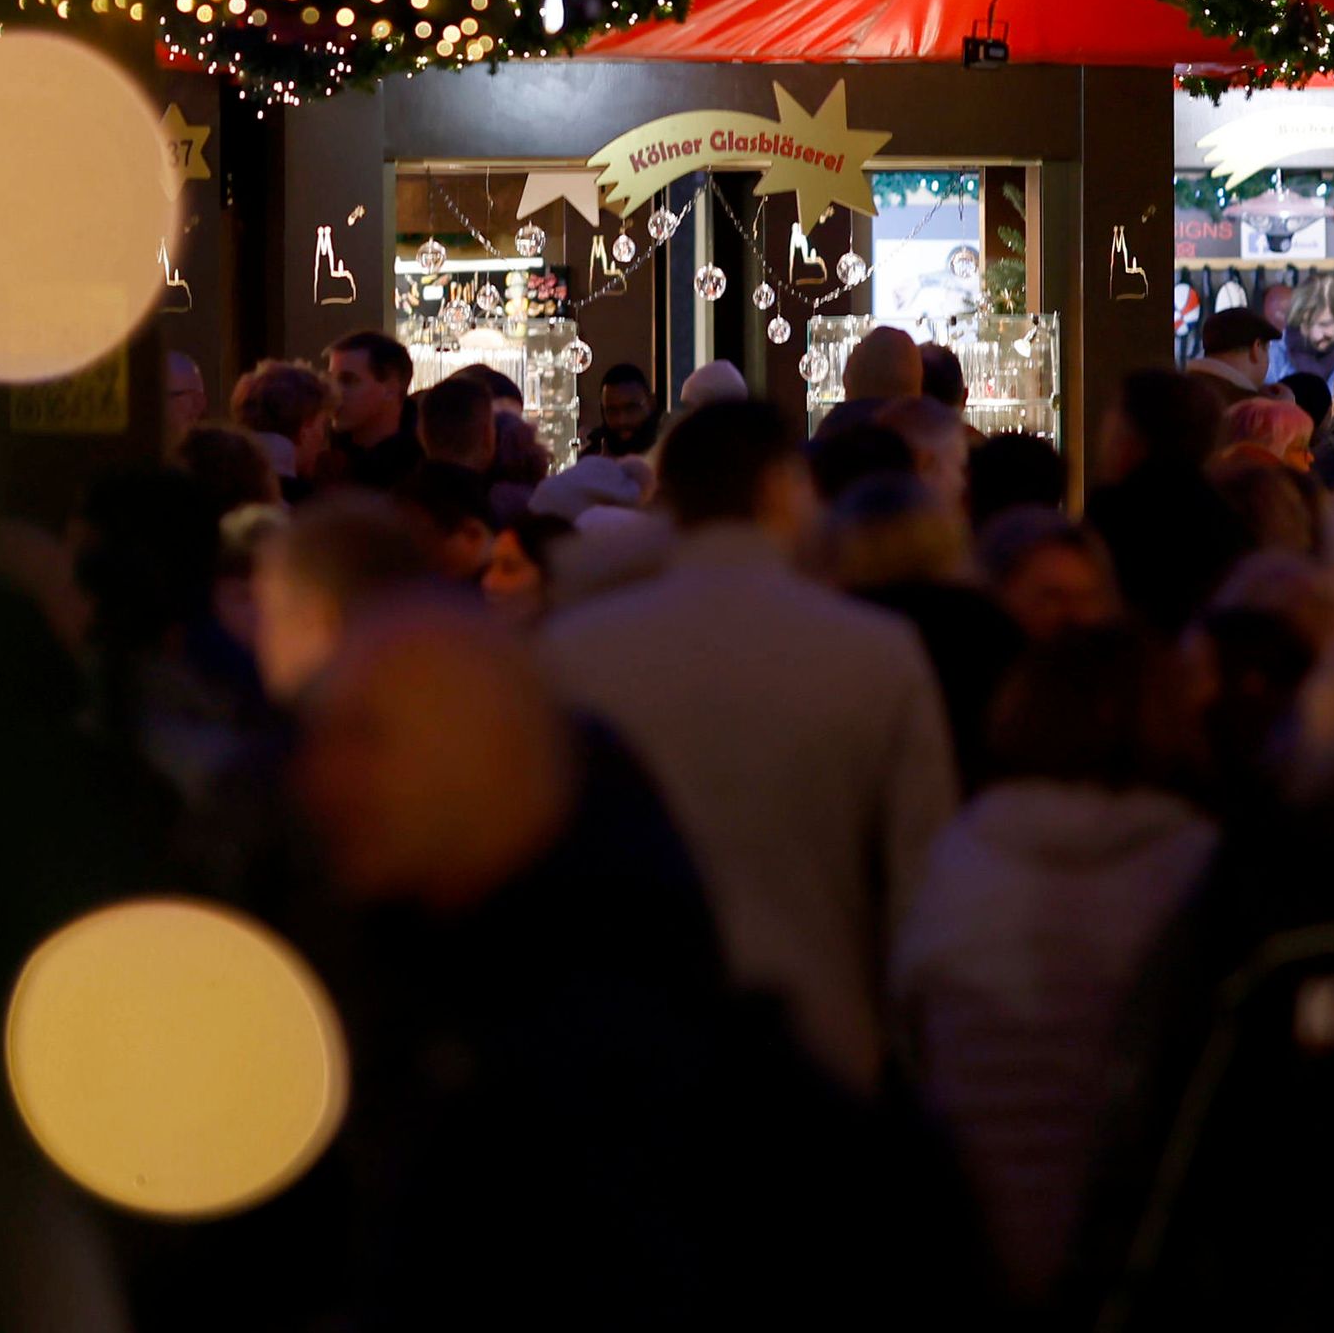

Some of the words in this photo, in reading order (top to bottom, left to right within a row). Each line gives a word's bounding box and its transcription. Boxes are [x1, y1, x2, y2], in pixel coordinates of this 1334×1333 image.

[629, 137, 703, 173] Kölner
[709, 129, 845, 173] Glasbläserei
[1175, 221, 1233, 240] IGNS
